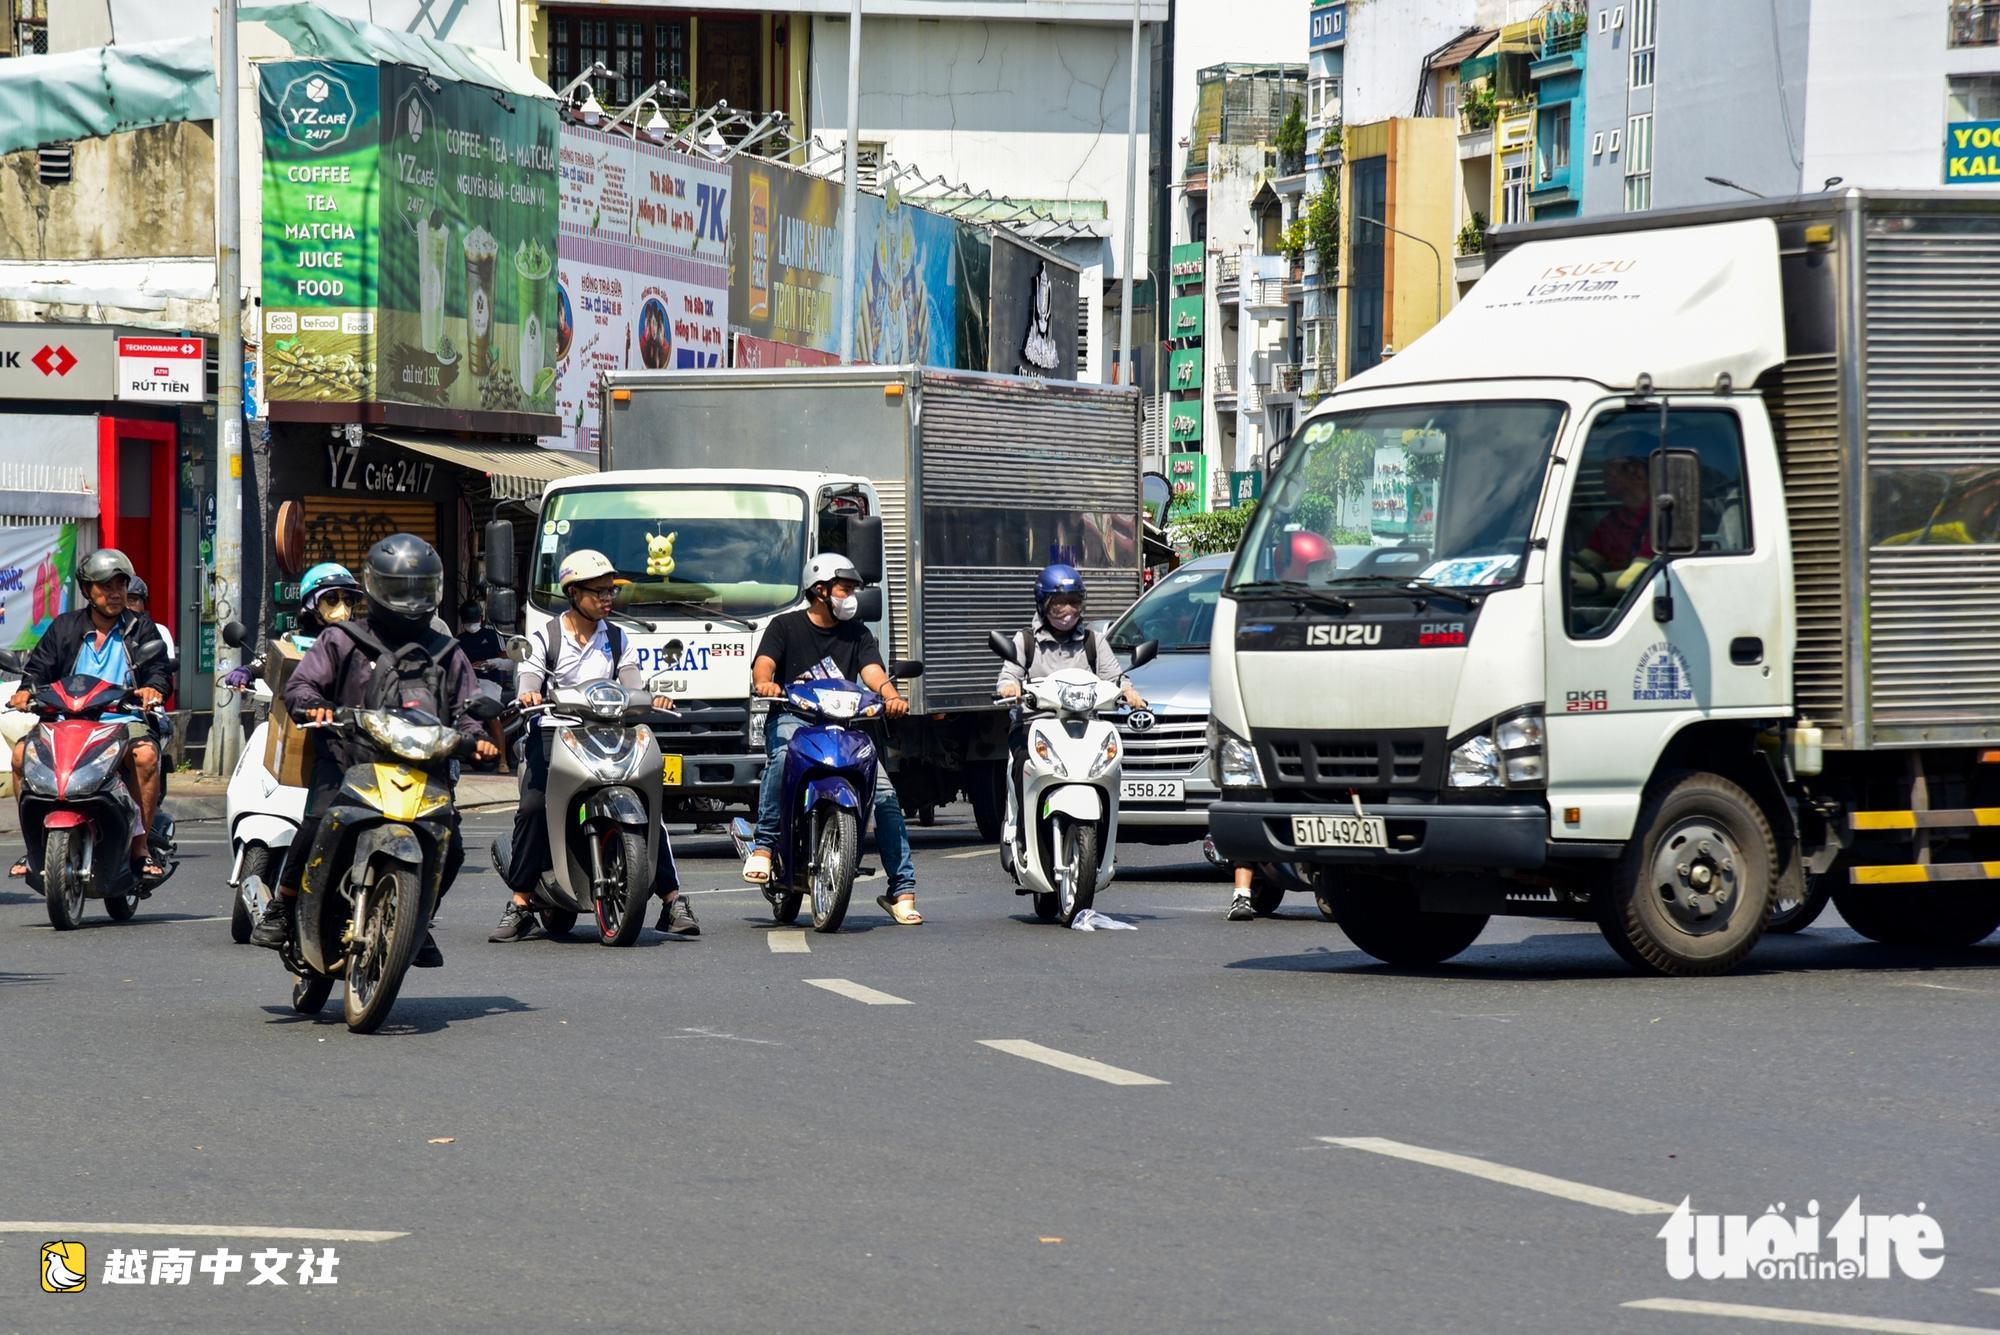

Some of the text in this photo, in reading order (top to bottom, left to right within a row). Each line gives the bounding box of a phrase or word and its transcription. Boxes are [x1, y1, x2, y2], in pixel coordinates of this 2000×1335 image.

[290, 108, 347, 124] YZ CAFÉ
[305, 130, 332, 139] 24/7
[446, 129, 555, 170] COFFEE TEA MATCHA
[287, 166, 351, 183] COFFEE
[397, 152, 434, 187] YZ CAFÉ
[1950, 156, 2000, 177] KAL
[456, 172, 487, 197] NGUYÊN
[488, 173, 503, 200] BẢN
[510, 174, 535, 205] CHUẨN
[536, 188, 545, 212] VỊ
[650, 170, 660, 192] Trà
[661, 173, 673, 195] Sữa
[674, 177, 686, 199] 12K
[306, 195, 338, 211] TEA
[407, 196, 424, 213] 24/7
[696, 182, 727, 241] 7K
[638, 196, 694, 234] Hồng Trà Lục Trà
[285, 223, 355, 240] MATCHA
[778, 213, 805, 272] LẠNH
[296, 252, 343, 268] JUICE
[1541, 260, 1637, 279] ISUZU
[297, 280, 344, 296] FOOD
[684, 295, 714, 317] Trà Sữa 12K
[272, 315, 293, 323] Grab
[347, 323, 369, 331] Food
[675, 318, 689, 342] Hồng
[690, 321, 698, 340] Trà
[702, 326, 711, 347] Lục
[712, 327, 721, 345] Trà
[125, 344, 179, 353] TECHCOMBANK
[402, 364, 440, 386] chỉ từ 19K
[132, 379, 189, 393] RÚT TIỀN
[328, 444, 435, 494] YZ Café 24/7
[286, 615, 298, 629] TEA
[1420, 623, 1464, 634] QKR
[1306, 624, 1382, 646] ISUZU
[650, 679, 688, 693] UZU
[1566, 690, 1608, 701] QKR
[1566, 700, 1608, 712] 230
[1120, 783, 1176, 797] -558.22
[1296, 820, 1380, 845] 51D-492.81
